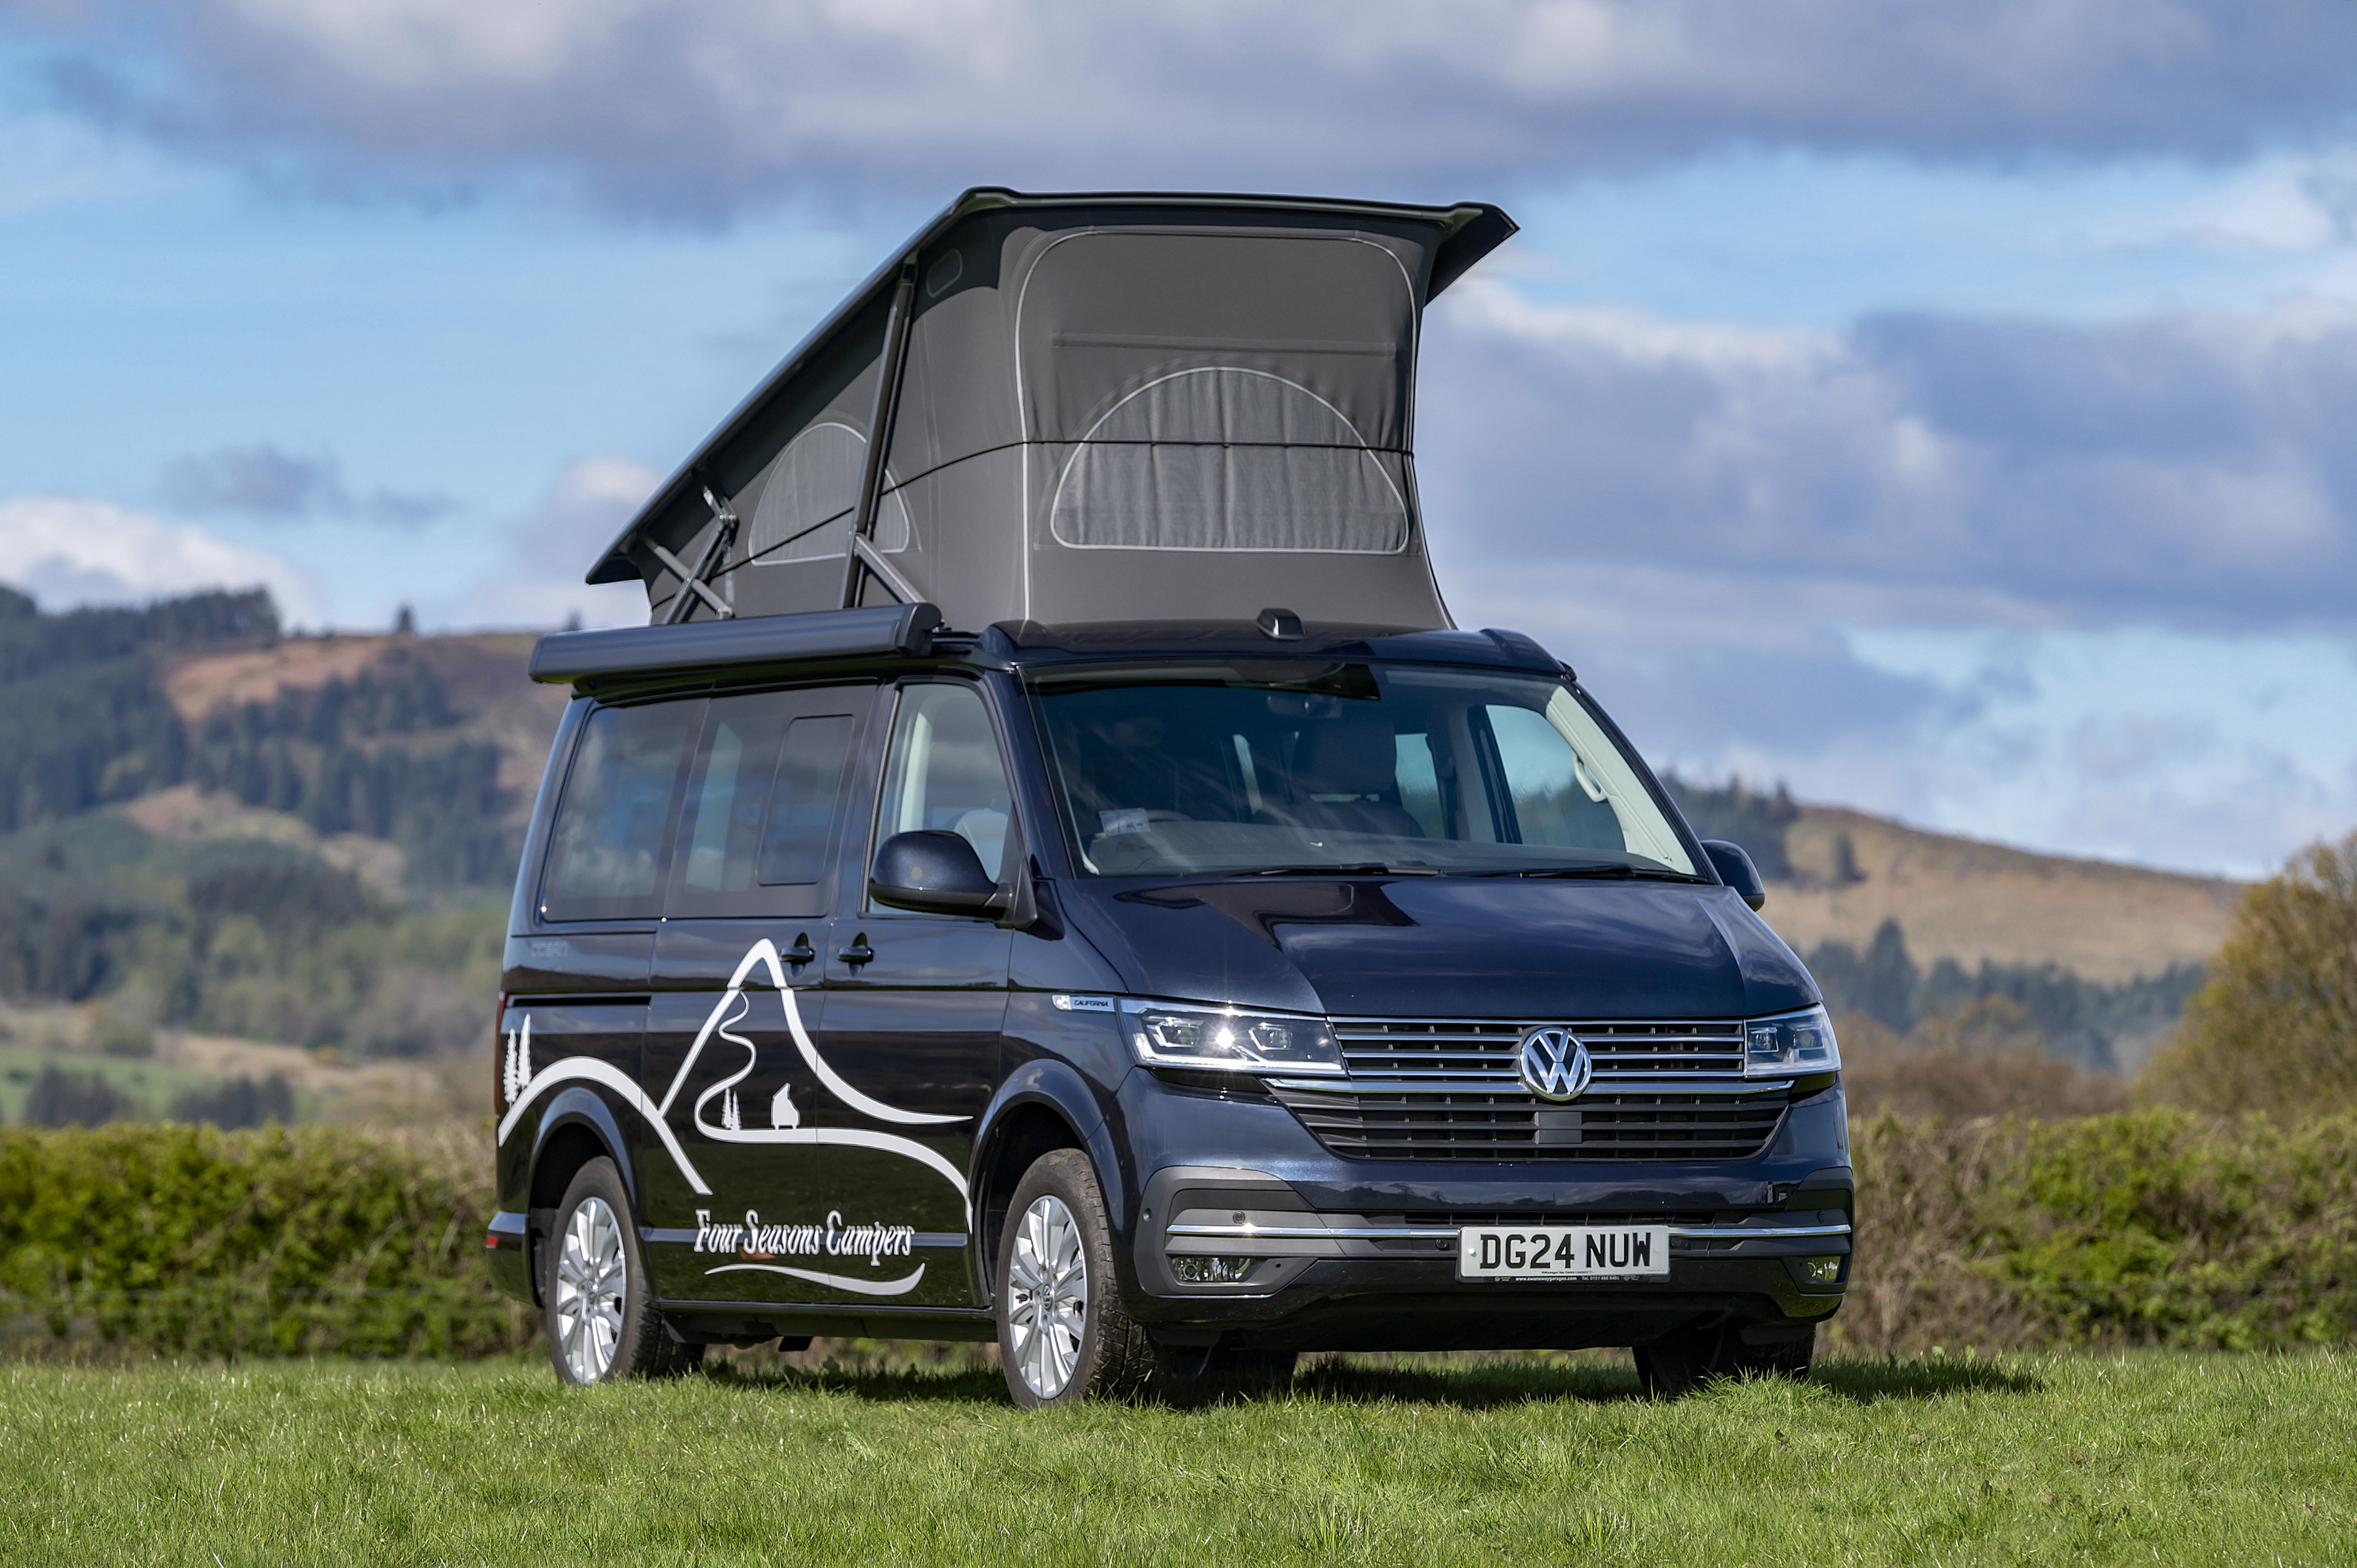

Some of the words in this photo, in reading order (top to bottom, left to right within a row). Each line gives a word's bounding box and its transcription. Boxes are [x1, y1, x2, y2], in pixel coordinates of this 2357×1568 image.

[694, 1209, 743, 1253] Four
[744, 1209, 824, 1255] Seasons
[826, 1210, 916, 1266] Campers
[1480, 1233, 1575, 1269] DG24
[1586, 1232, 1652, 1268] NUW
